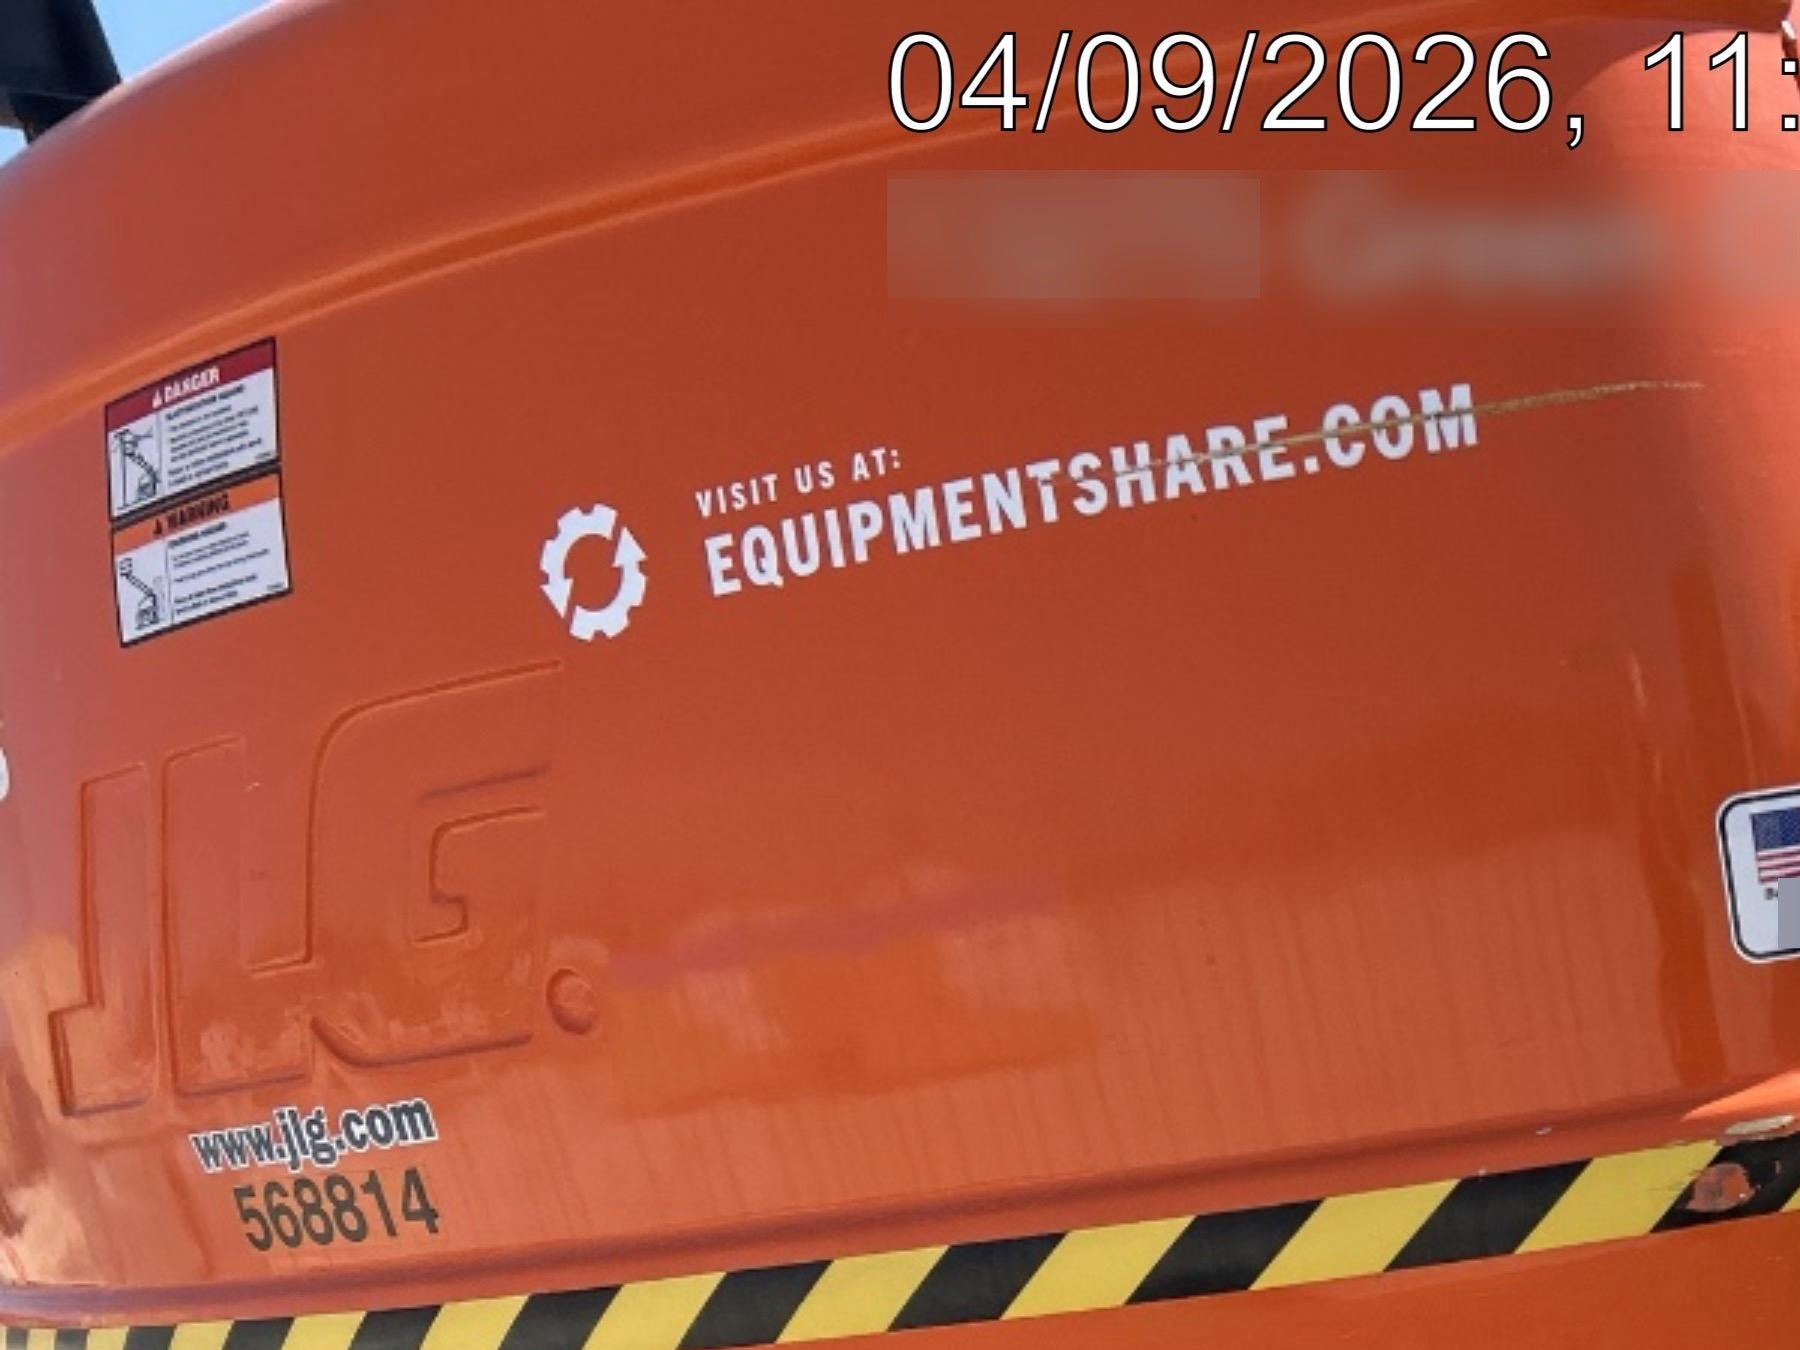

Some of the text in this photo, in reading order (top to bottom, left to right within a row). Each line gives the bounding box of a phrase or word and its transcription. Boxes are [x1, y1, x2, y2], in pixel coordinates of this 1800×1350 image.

[164, 366, 221, 404] DANGER
[167, 491, 230, 528] WARNING
[695, 447, 902, 519] VISIT US AT:
[703, 383, 1480, 597] EQUIPMENTSHARE.COM
[190, 1098, 440, 1173] www.jlg.com
[233, 1166, 440, 1251] 568814
